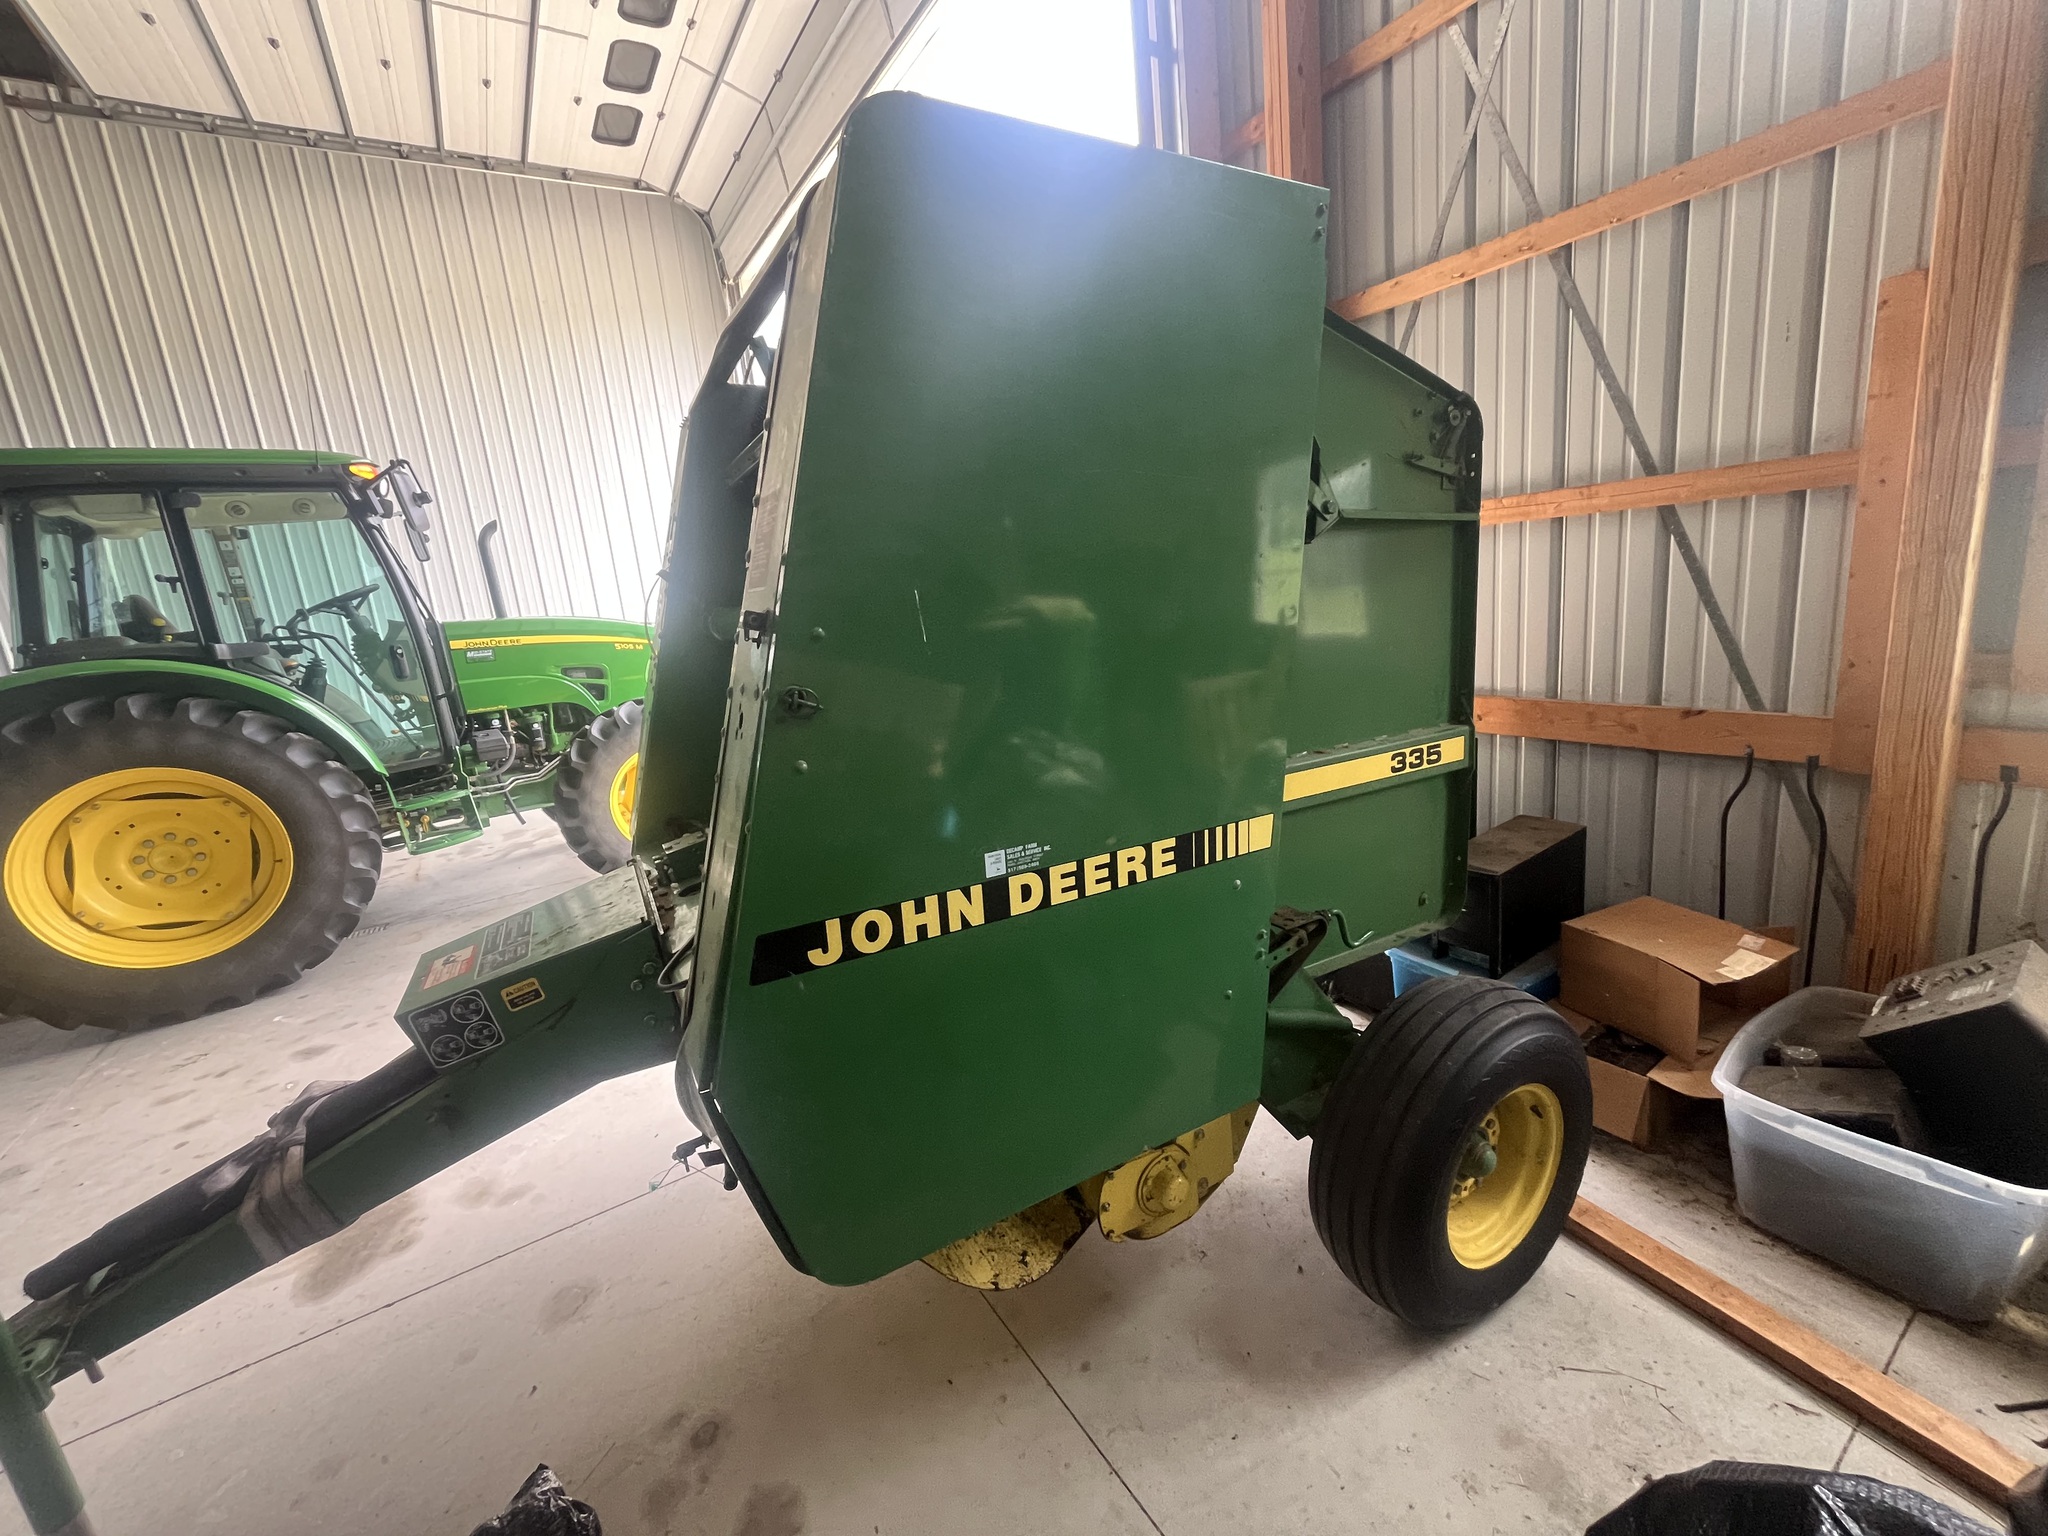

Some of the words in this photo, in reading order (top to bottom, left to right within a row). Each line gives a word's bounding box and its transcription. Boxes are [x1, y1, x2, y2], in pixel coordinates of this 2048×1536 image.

[464, 640, 489, 648] JOHN
[489, 638, 521, 646] DEERE
[1390, 743, 1442, 774] 335
[807, 883, 985, 966] JOHN
[1008, 836, 1177, 917] DEERE
[513, 982, 536, 994] CAUTION
